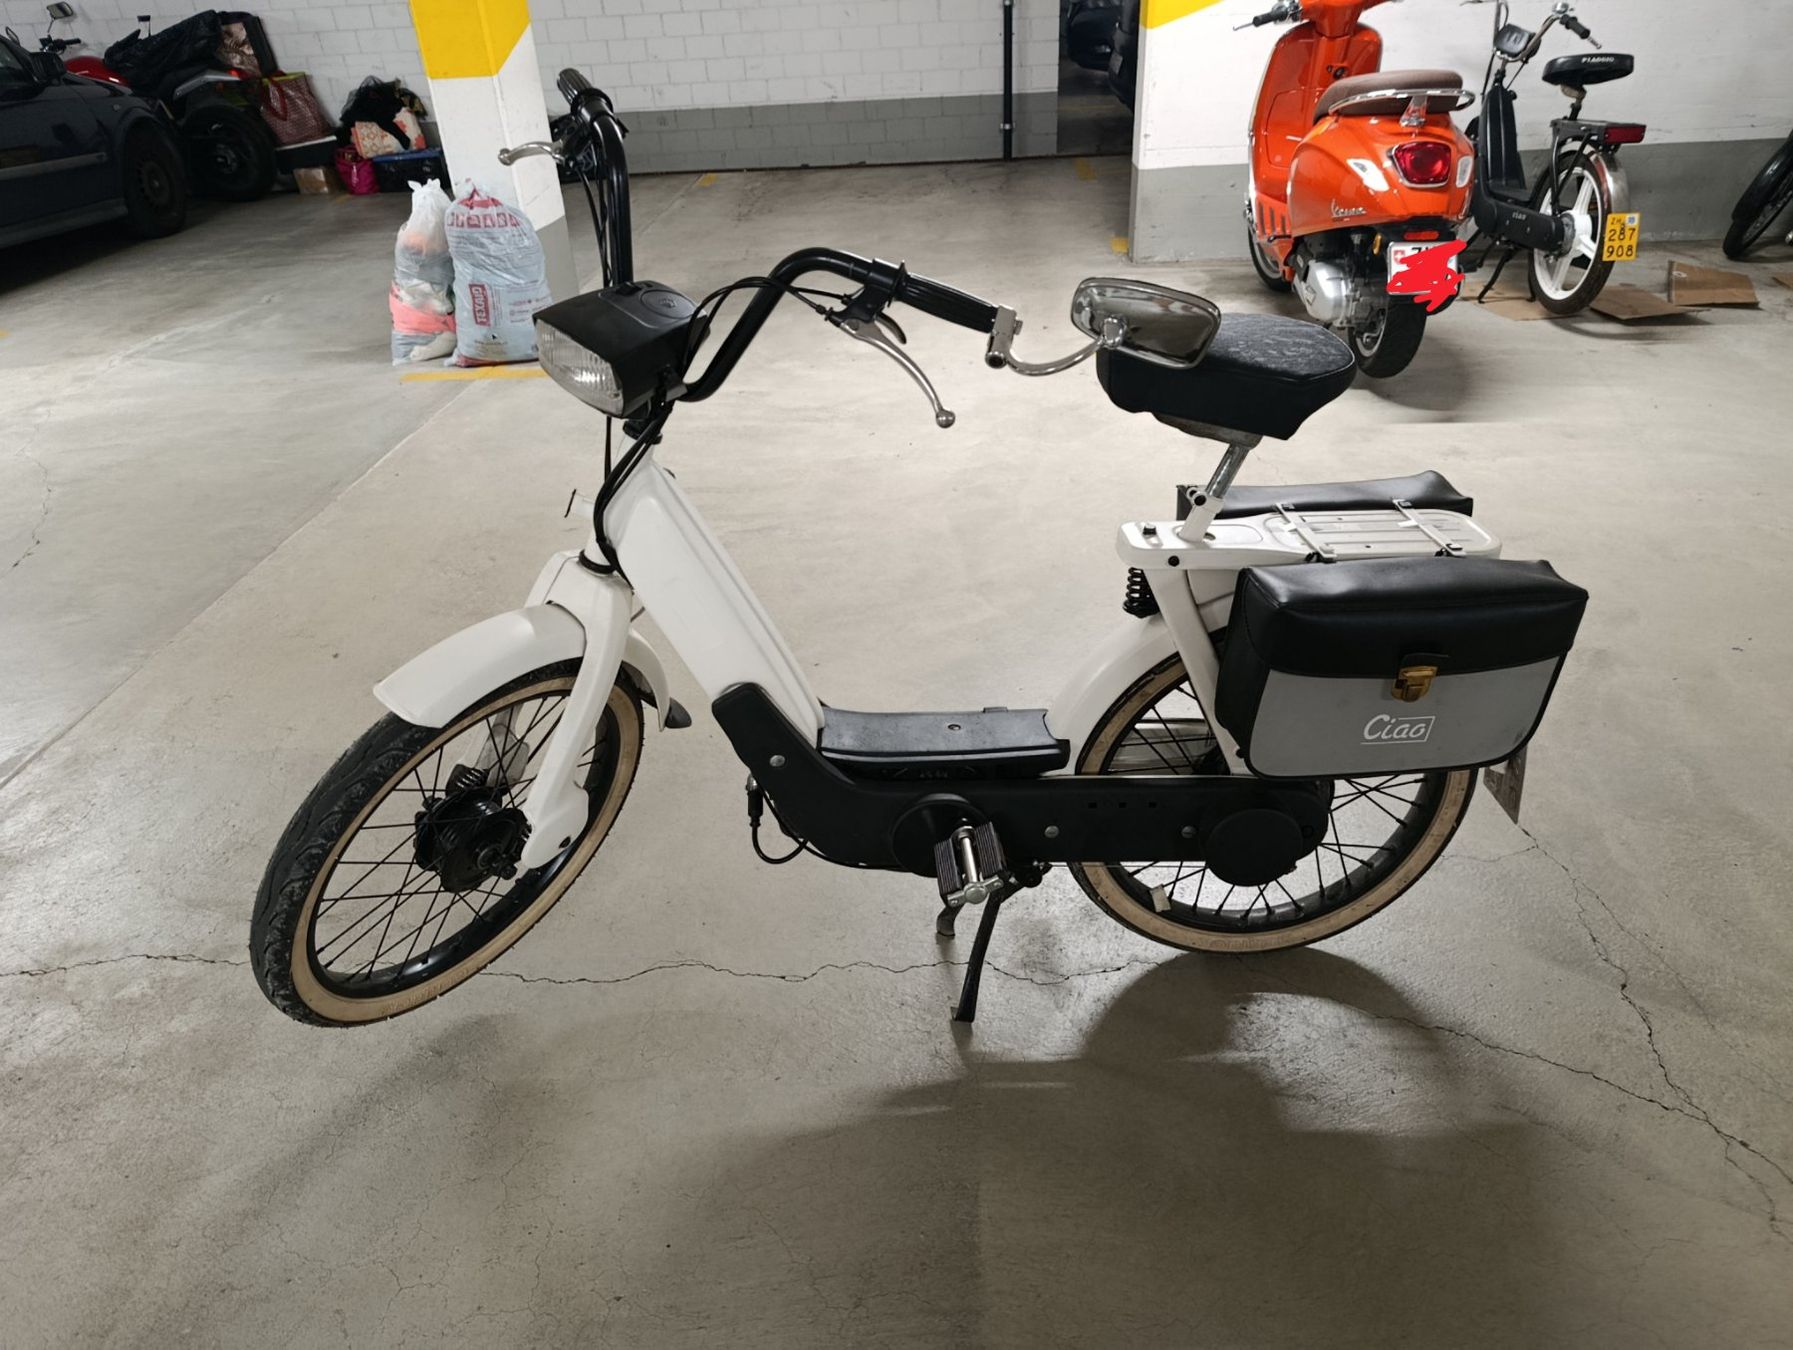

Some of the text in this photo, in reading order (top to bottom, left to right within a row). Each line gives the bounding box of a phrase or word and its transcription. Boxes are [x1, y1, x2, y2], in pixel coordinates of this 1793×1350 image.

[1608, 227, 1636, 242] 287
[1606, 244, 1634, 259] 908
[1363, 714, 1426, 740] Ciao
